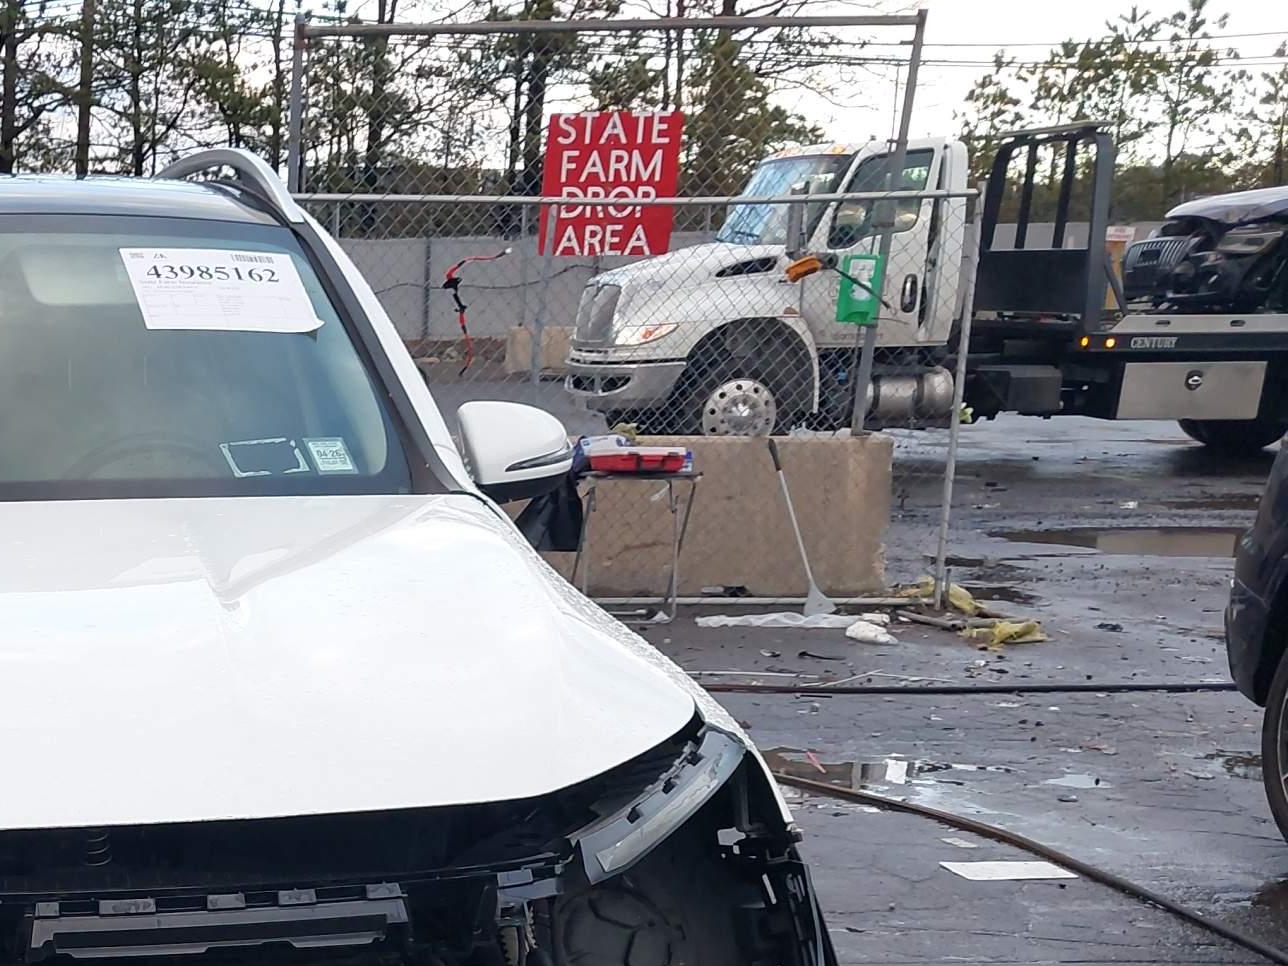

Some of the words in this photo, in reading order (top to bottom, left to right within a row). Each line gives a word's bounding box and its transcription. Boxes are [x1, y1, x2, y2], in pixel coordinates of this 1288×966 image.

[557, 111, 673, 145] STATE
[559, 149, 663, 183] FARM
[559, 186, 656, 219] DROP
[554, 224, 651, 256] AREA
[146, 264, 280, 283] 43985162
[1130, 336, 1179, 349] CENTURY
